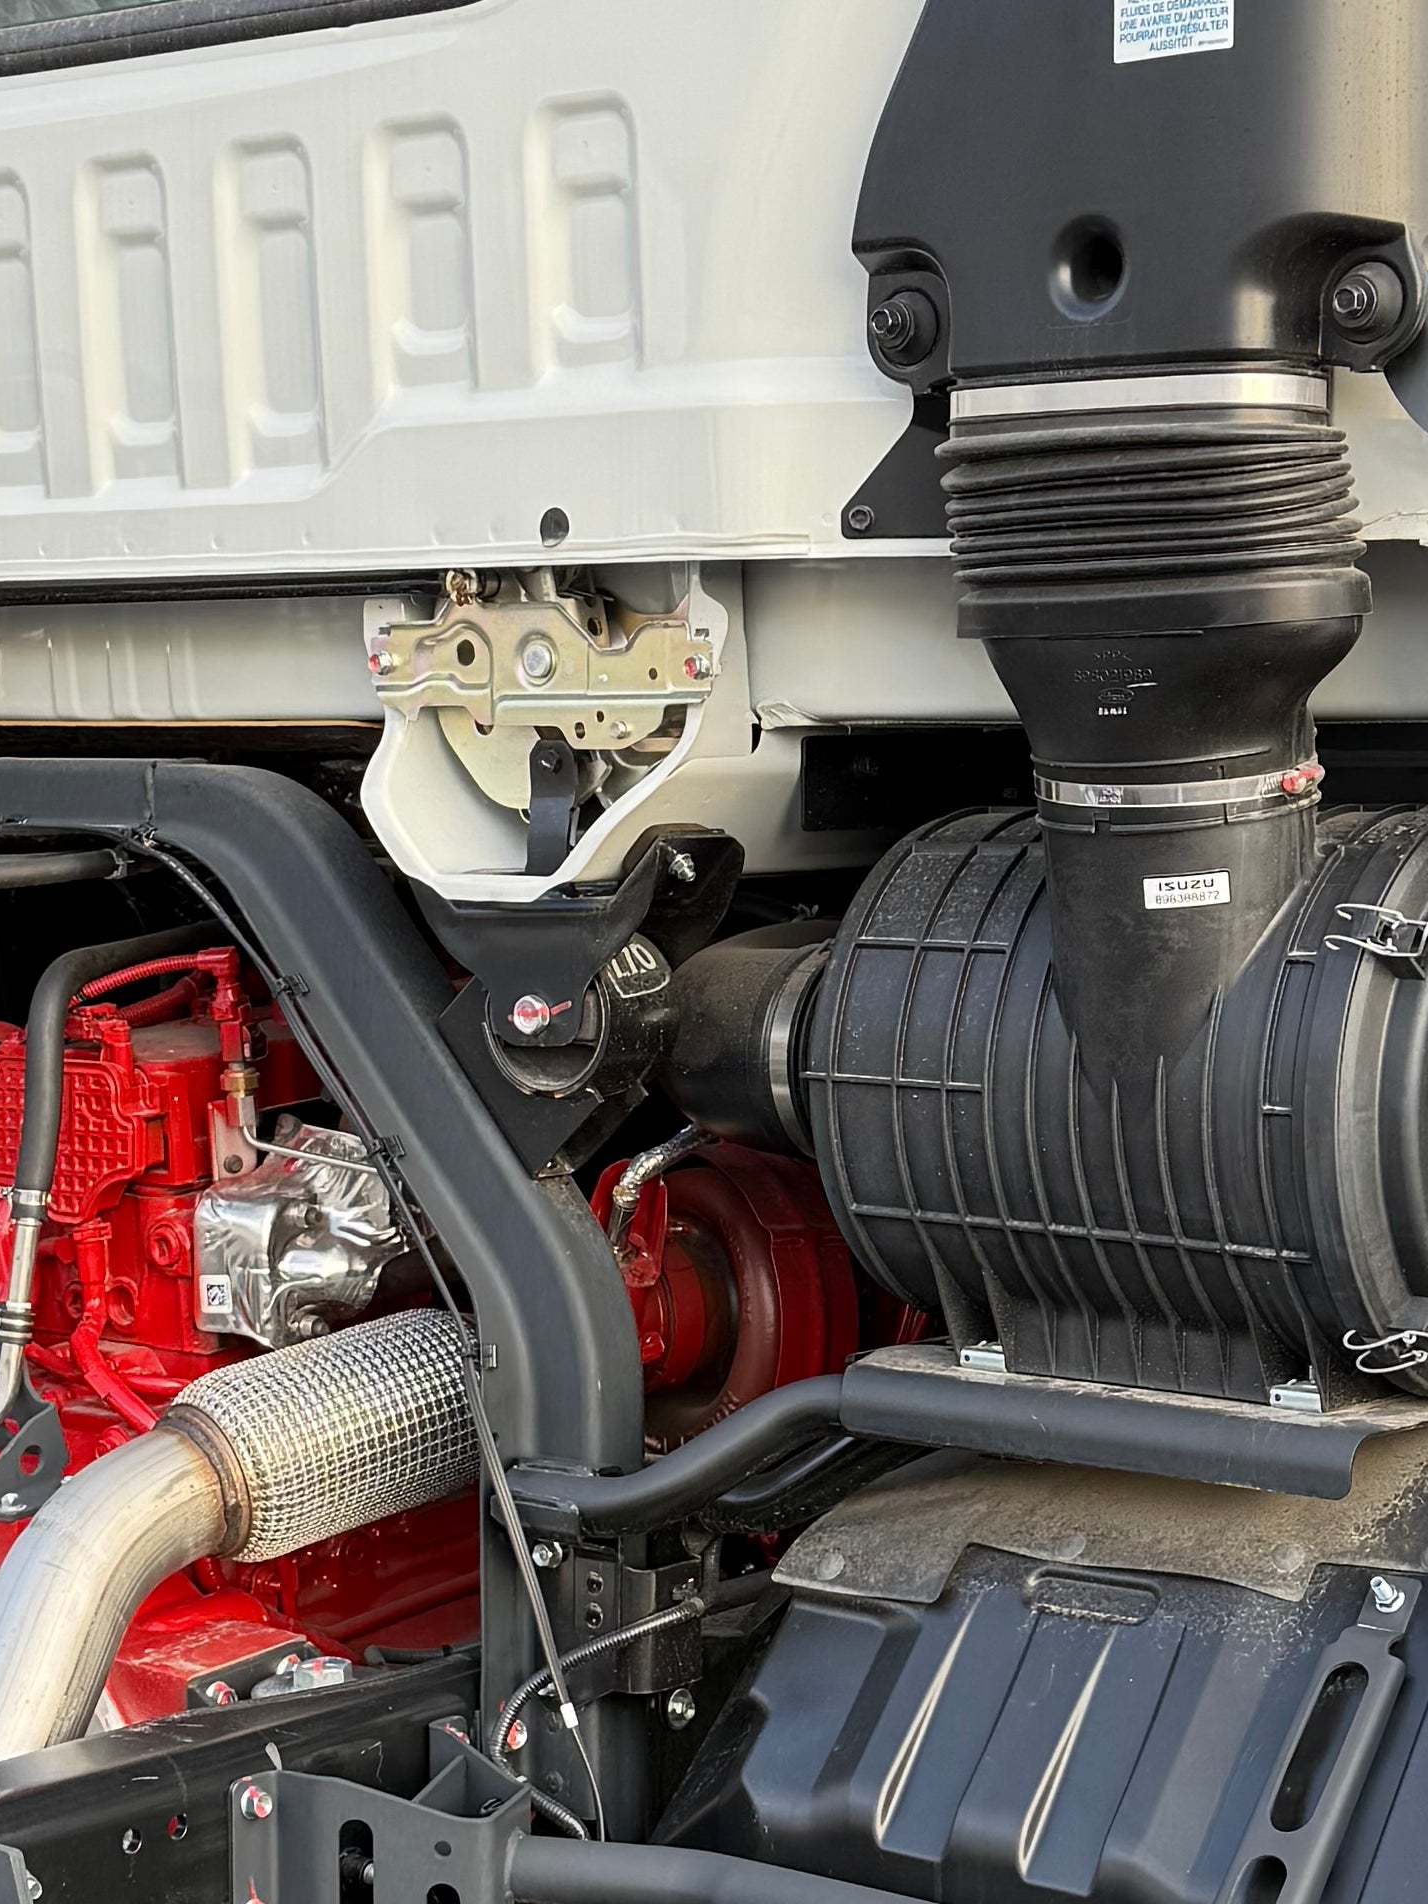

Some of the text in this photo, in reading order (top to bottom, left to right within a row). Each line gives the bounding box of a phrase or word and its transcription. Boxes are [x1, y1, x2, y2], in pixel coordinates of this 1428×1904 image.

[1119, 6, 1229, 31] UNE AVARIE DU MOTEUR
[1120, 4, 1150, 18] FLUIDE
[1153, 1, 1164, 14] DE
[1119, 18, 1229, 44] POURRAIT EN RÉSULTER
[1158, 878, 1215, 892] ISUZU
